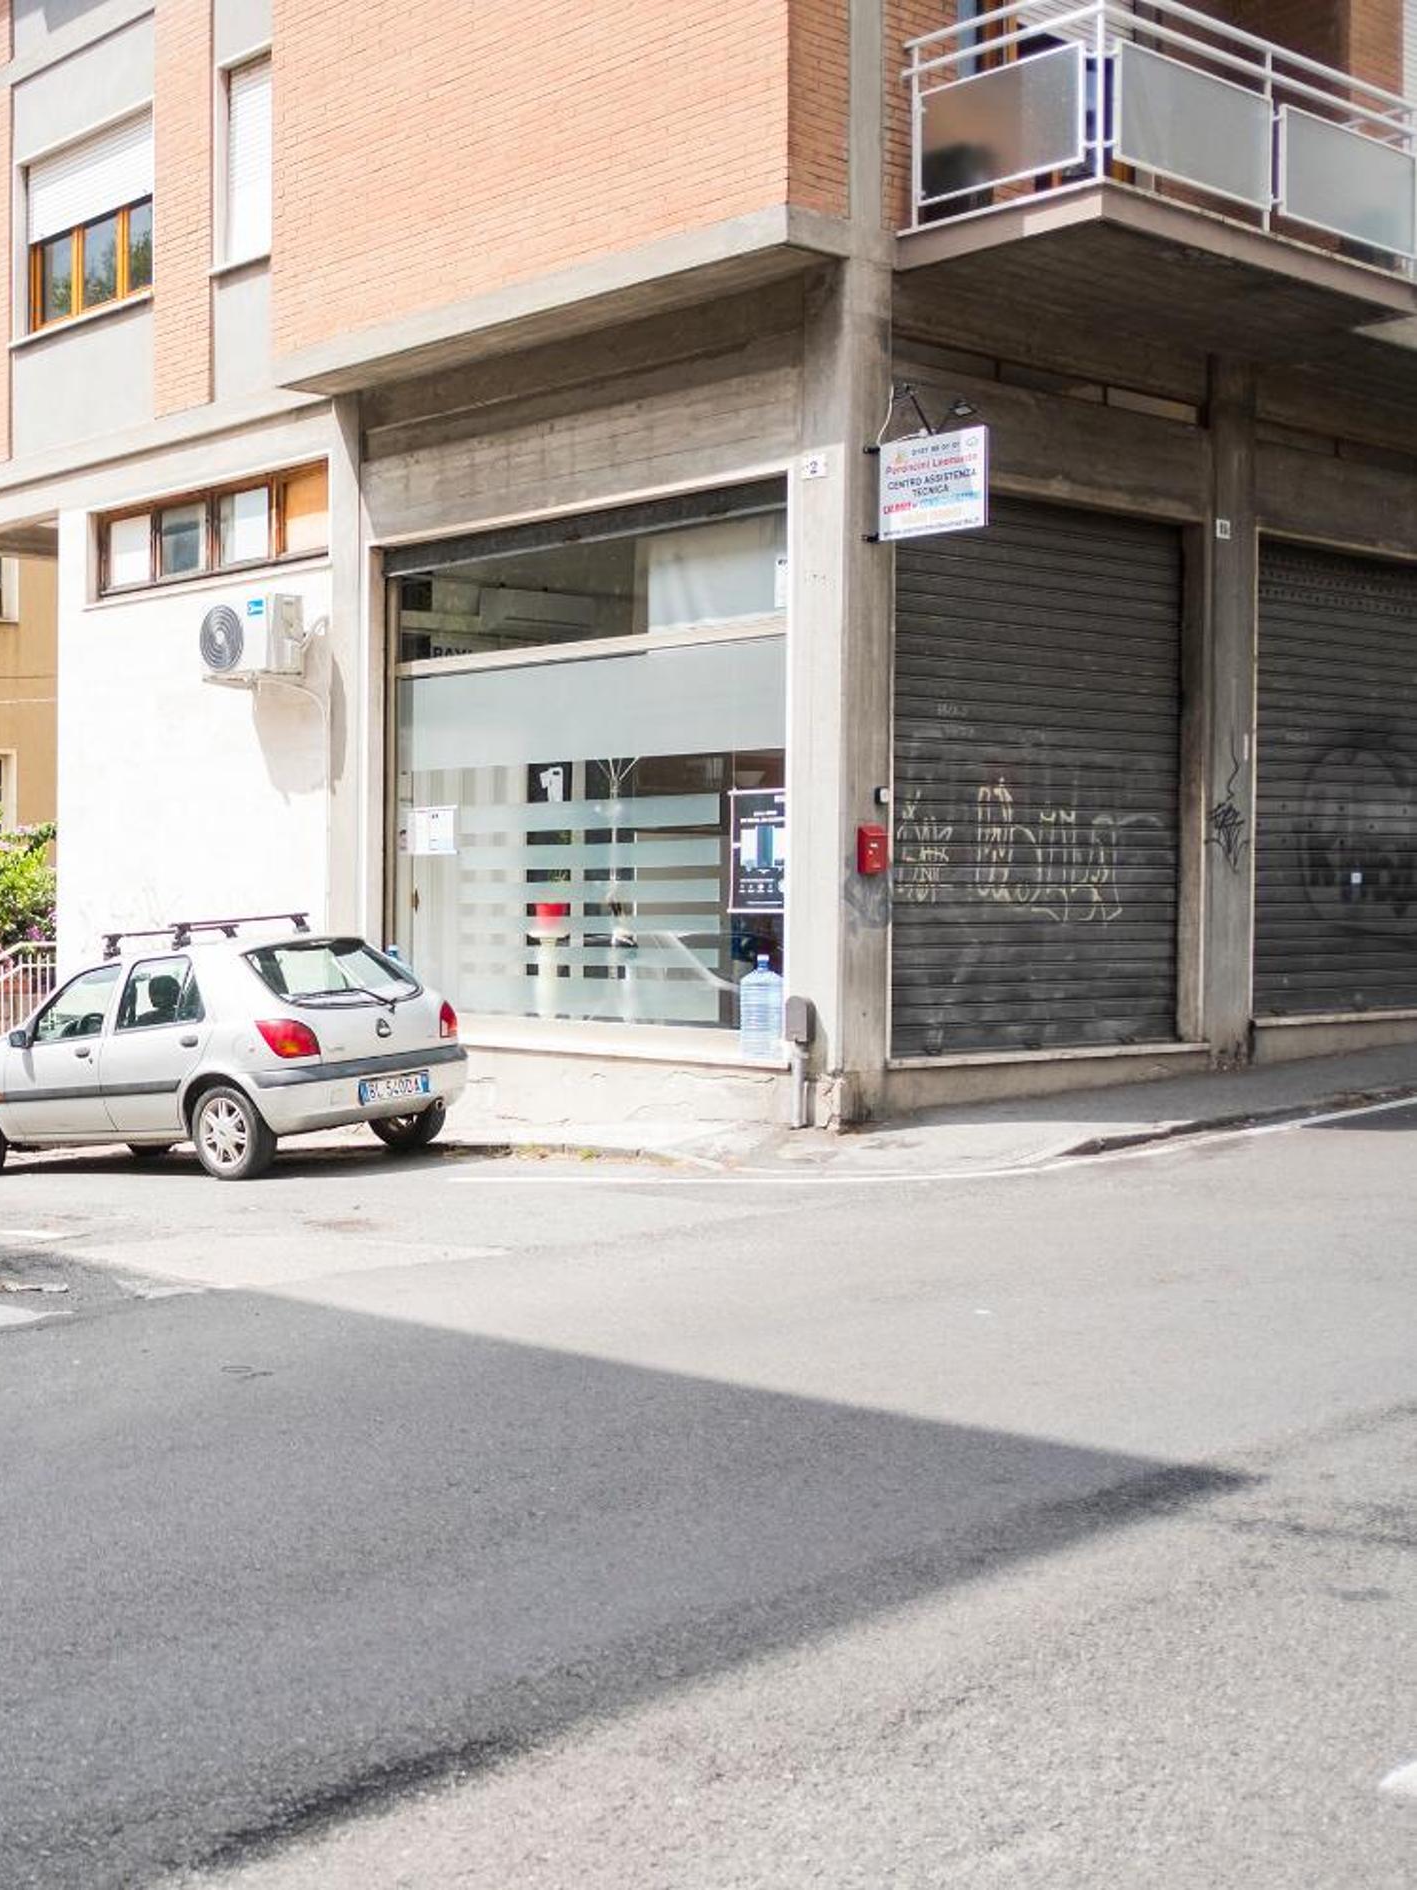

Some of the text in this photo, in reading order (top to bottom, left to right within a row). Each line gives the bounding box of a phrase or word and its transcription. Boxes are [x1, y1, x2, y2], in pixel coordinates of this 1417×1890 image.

[888, 467, 976, 491] CENTRO ASSISTENZA
[912, 483, 949, 497] TECNICA
